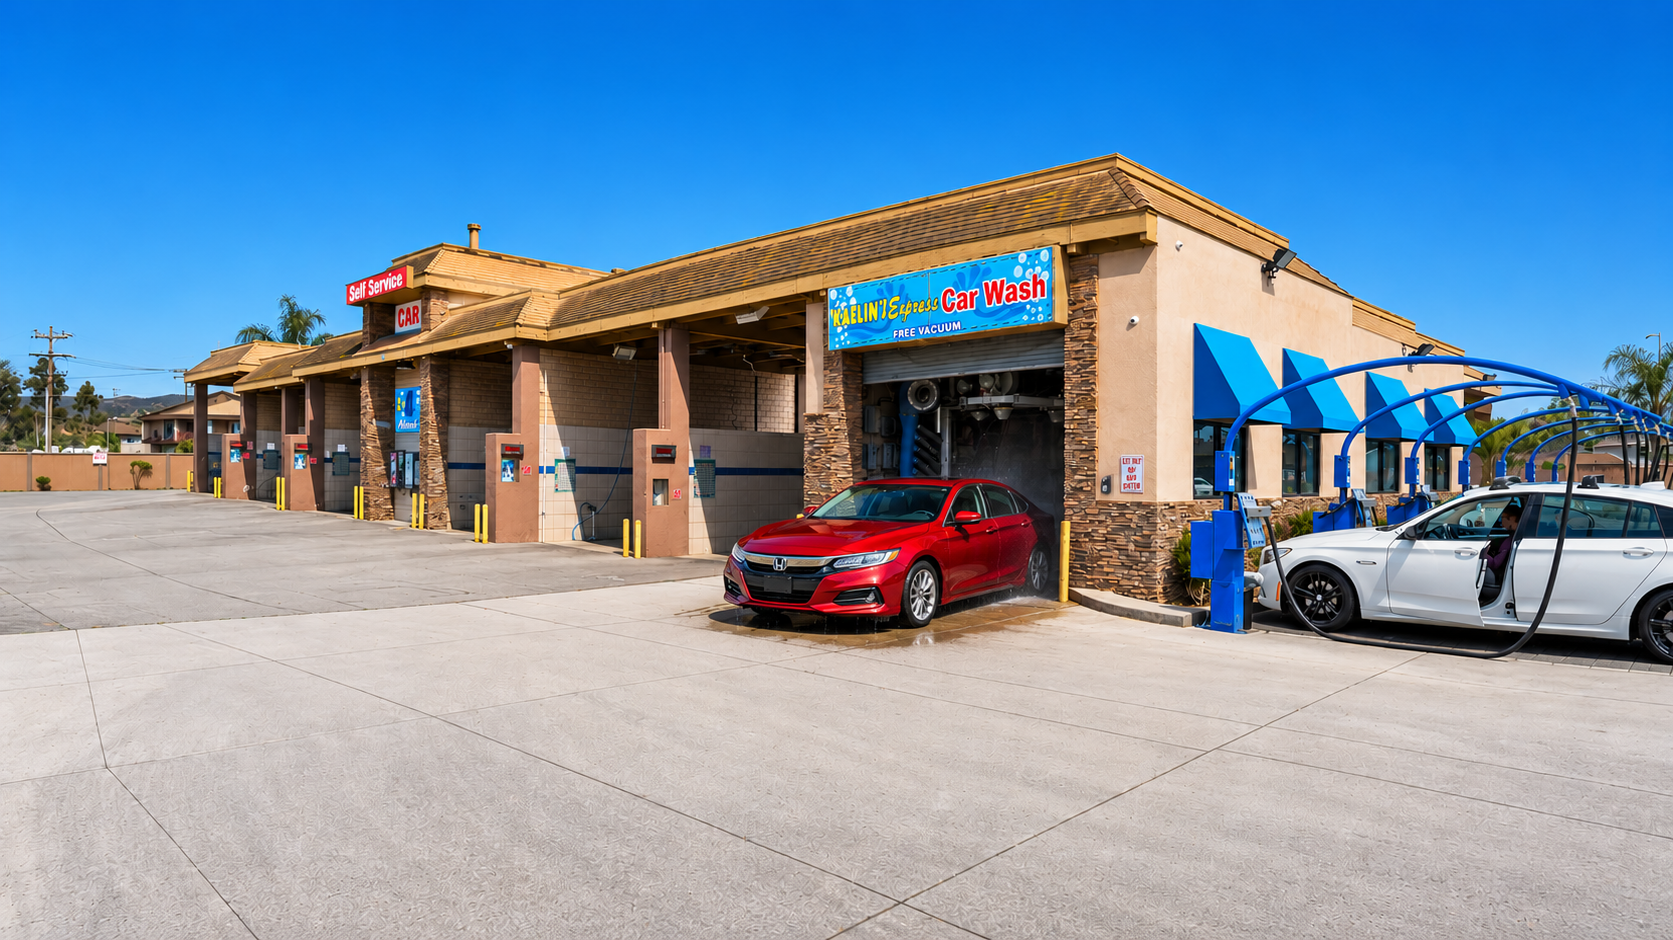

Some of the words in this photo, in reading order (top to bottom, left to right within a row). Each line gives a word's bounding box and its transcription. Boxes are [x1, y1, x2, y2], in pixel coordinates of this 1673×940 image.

[349, 281, 367, 302] Self
[368, 273, 403, 296] Service
[941, 287, 979, 314] Car
[983, 273, 1046, 307] Wash
[397, 305, 420, 328] CAR
[893, 327, 916, 339] FREE
[918, 320, 961, 335] VACUUM
